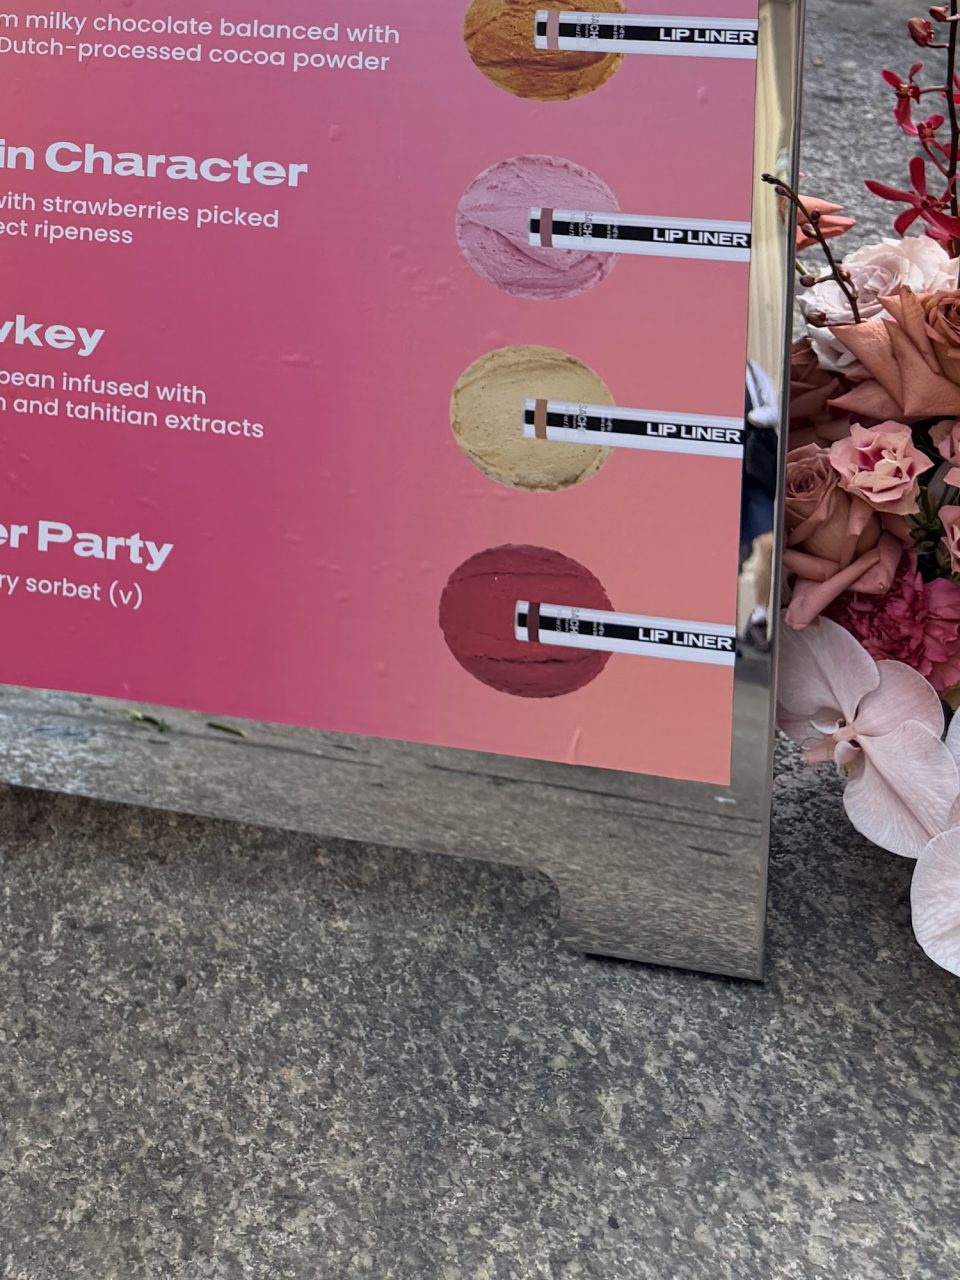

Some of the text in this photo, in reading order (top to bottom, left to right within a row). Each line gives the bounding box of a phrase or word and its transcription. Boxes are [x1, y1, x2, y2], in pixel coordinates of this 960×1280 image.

[25, 10, 88, 36] milky
[92, 13, 213, 36] chocolate
[219, 17, 339, 42] balanced
[346, 23, 400, 44] with
[659, 28, 755, 44] LIP LINER
[208, 48, 286, 66] cocoa
[293, 50, 391, 73] powder
[44, 141, 309, 188] Character
[42, 195, 190, 222] strawberries
[196, 204, 279, 229] picked
[34, 219, 134, 245] ripeness
[653, 228, 748, 247] LIP LINER
[62, 371, 150, 400] infused
[155, 382, 207, 406] with
[12, 397, 59, 417] and
[65, 400, 158, 427] tahitian
[164, 413, 264, 439] extracts
[647, 423, 741, 443] LIP LINER
[37, 519, 175, 573] Party
[25, 577, 102, 602] sorbet
[108, 579, 143, 611] (v)
[638, 627, 733, 650] LIP LINER
